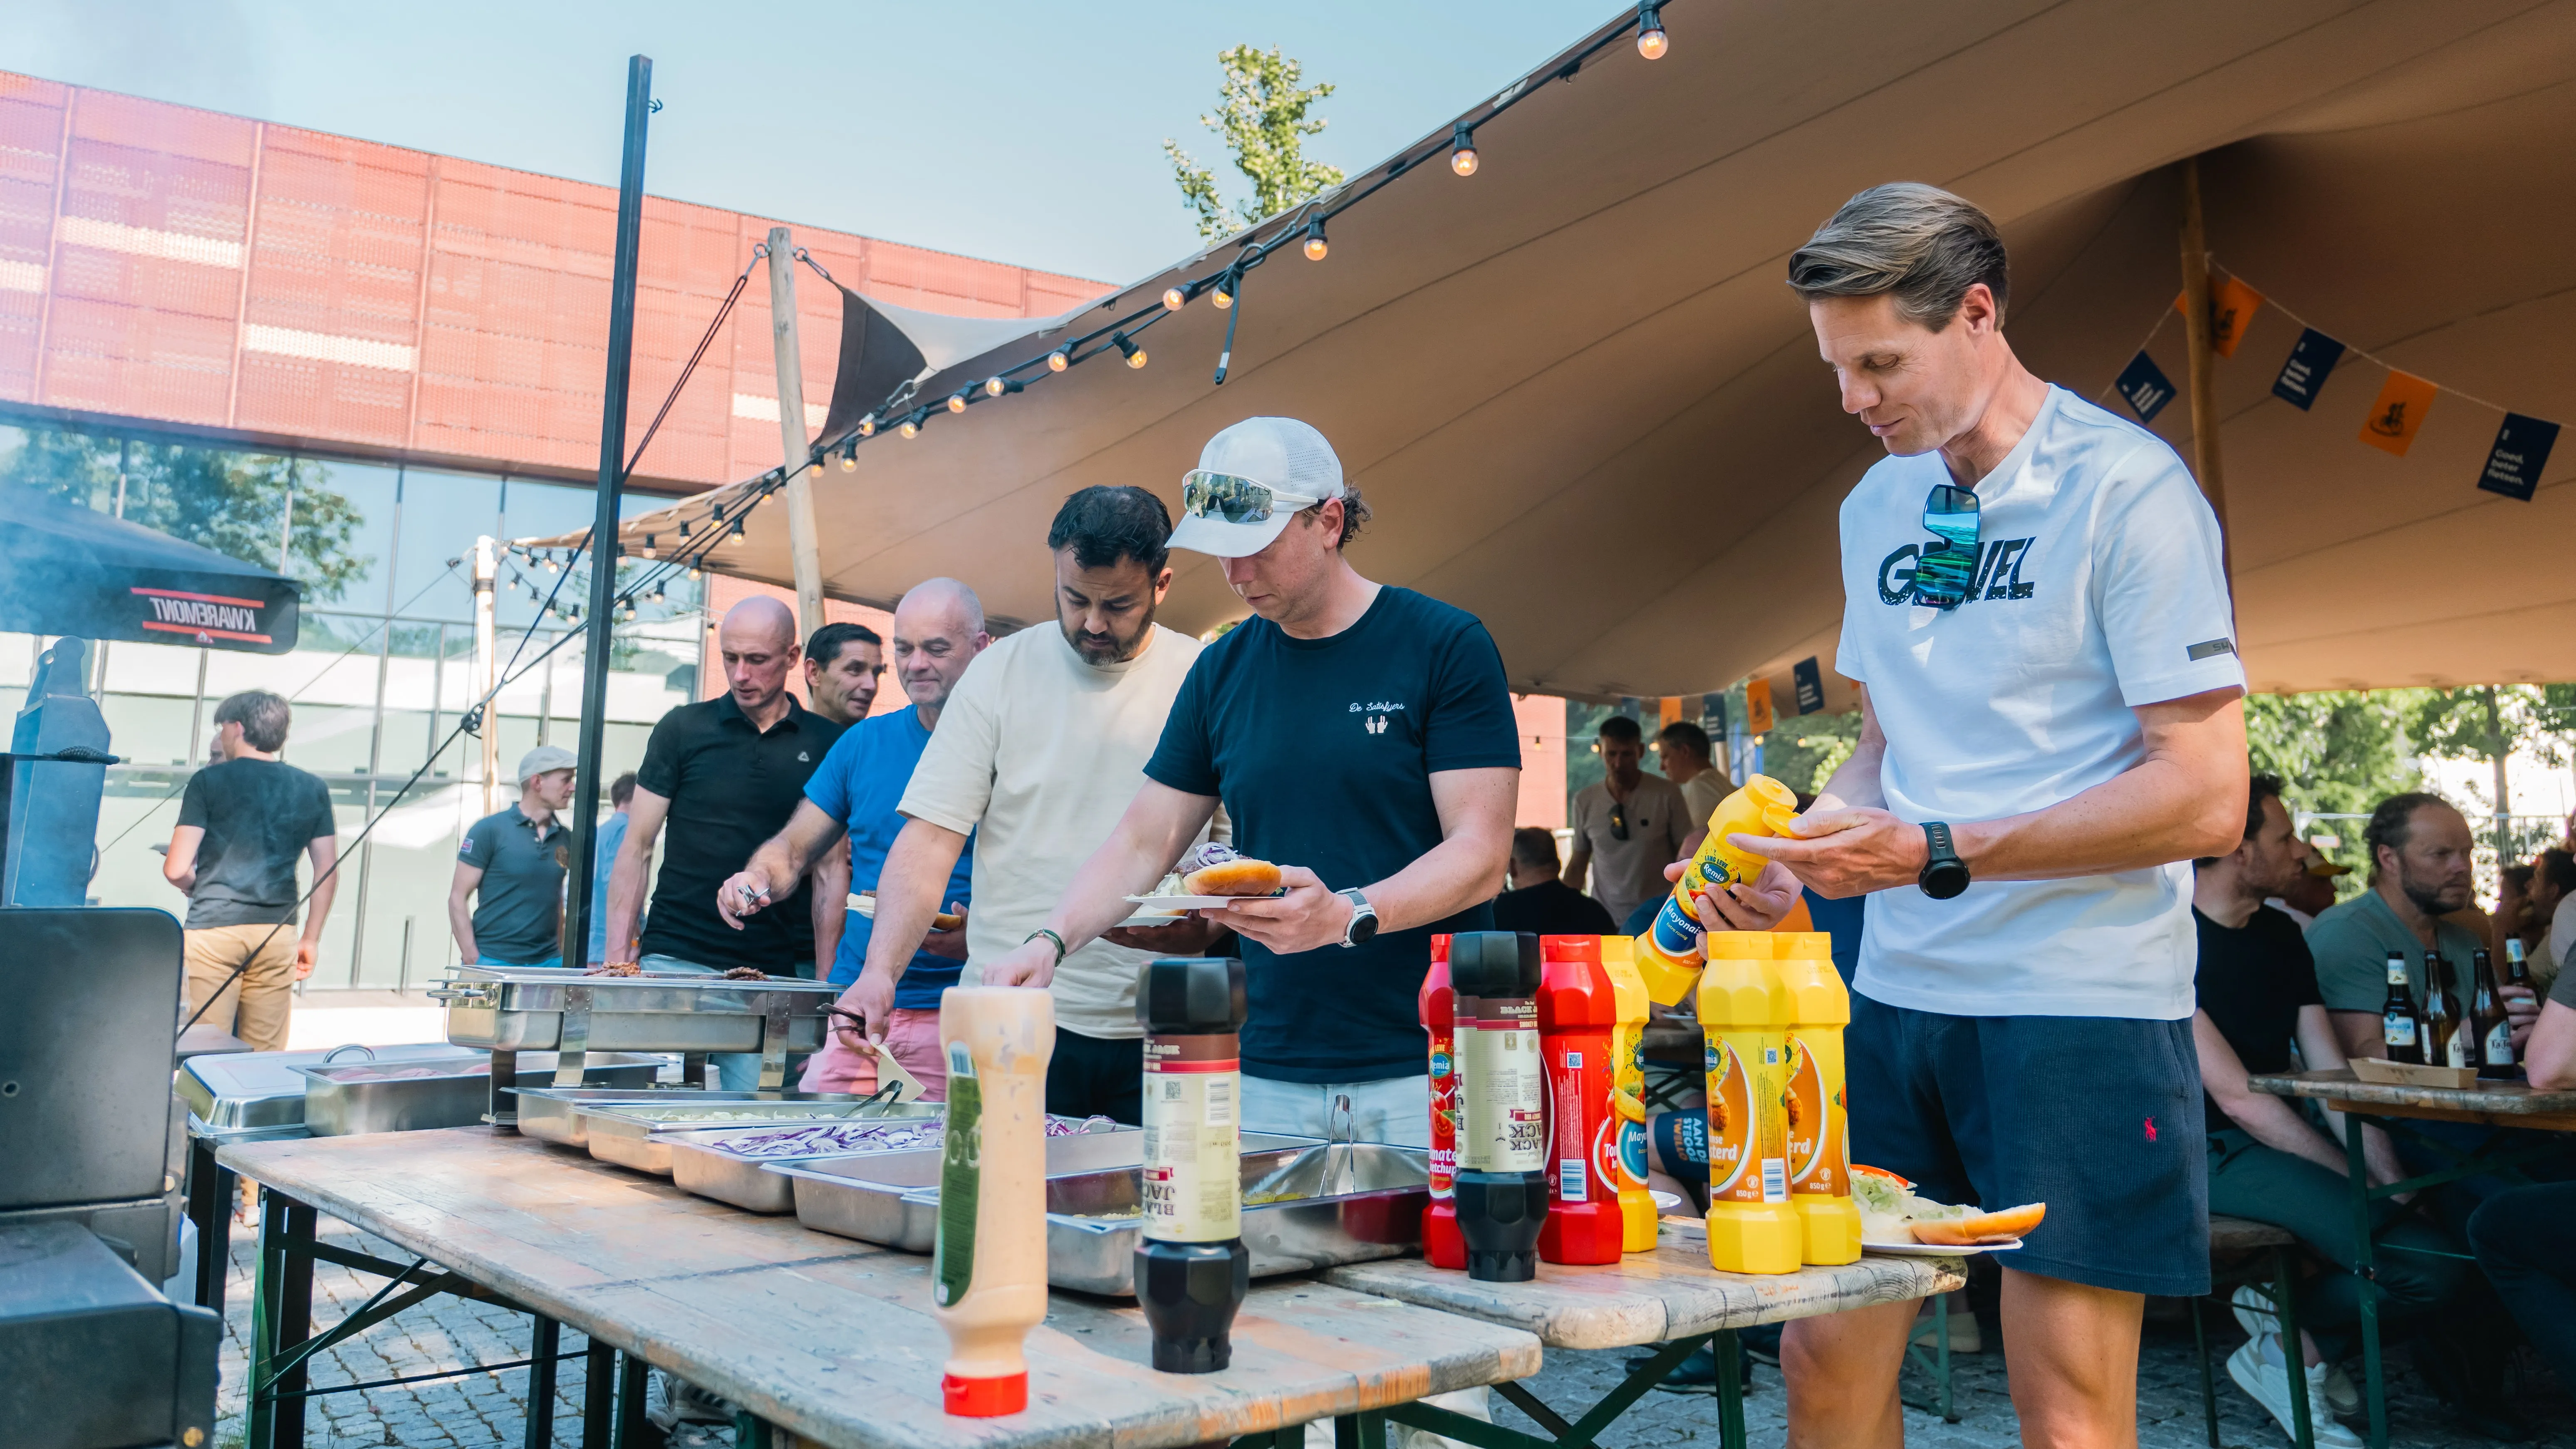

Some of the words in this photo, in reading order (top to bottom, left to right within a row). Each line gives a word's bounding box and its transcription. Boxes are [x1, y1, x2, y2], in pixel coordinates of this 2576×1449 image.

[1878, 536, 2037, 606] GVEL
[1349, 703, 1362, 712] De
[1366, 701, 1405, 712] Satisfyers
[1717, 859, 1729, 869] LEVE
[1704, 863, 1724, 882] Remia
[1666, 922, 1675, 932] Extra
[1500, 1006, 1532, 1014] BLACK
[1434, 1043, 1446, 1052] LEVE
[1430, 1060, 1450, 1071] Remia
[1693, 1118, 1704, 1147] AAN
